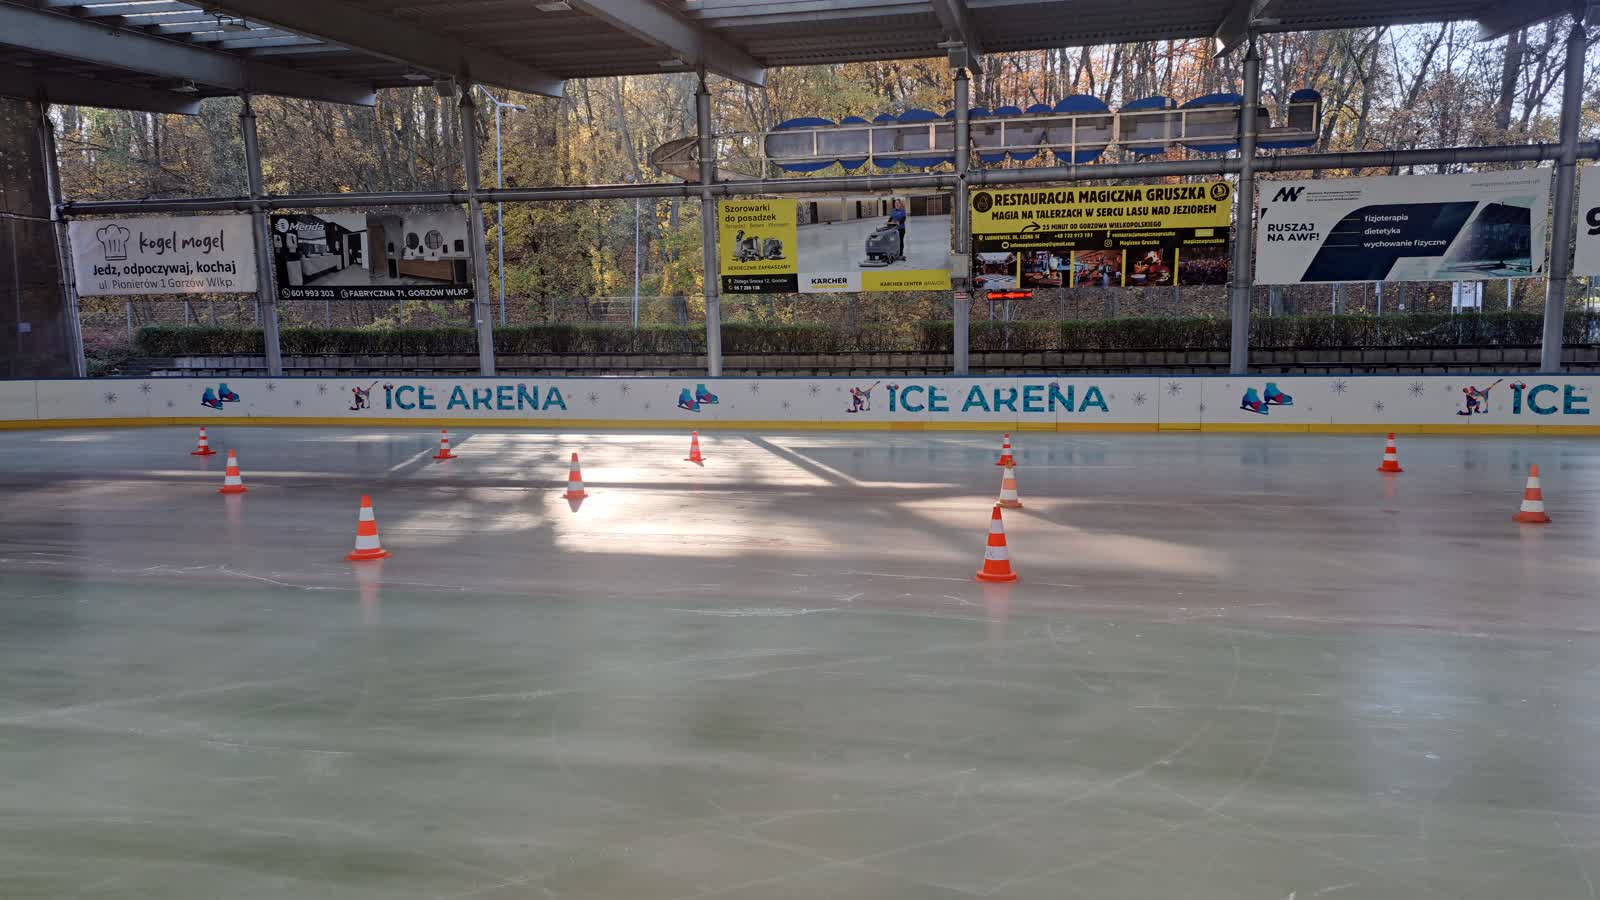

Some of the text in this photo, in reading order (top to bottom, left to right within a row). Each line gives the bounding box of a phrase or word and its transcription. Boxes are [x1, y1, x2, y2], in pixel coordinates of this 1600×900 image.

[995, 187, 1206, 206] RESTAURACJA MAGICZNA GRUSZKA
[724, 204, 770, 213] Szorowarki
[992, 204, 1216, 220] MAGIA NA TALERZACH W SERCU LASU NAD JEZIOREM
[737, 213, 776, 223] posadzek
[1364, 214, 1409, 223] fizjoterapia
[290, 222, 325, 231] Merida
[1109, 221, 1162, 229] WIELKOPOLSKIEGO
[1267, 223, 1314, 232] RUSZAJ
[1364, 227, 1400, 235] dietetyka
[139, 229, 224, 255] kogel mogel
[1267, 232, 1319, 242] NA AWF!
[1363, 239, 1446, 248] wychowanie fizyczne
[93, 260, 236, 277] Jedz, odpoczywaj, kochaj
[112, 278, 158, 289] Pionierów
[160, 278, 165, 288] 1
[168, 277, 204, 288] Gorzów
[350, 289, 395, 297] FABRYCZNA
[407, 288, 444, 297] GORZÓW
[445, 288, 469, 296] WLKP
[384, 384, 568, 411] ICE ARENA
[887, 383, 1109, 413] ICE ARENA
[1512, 383, 1590, 415] ICE
